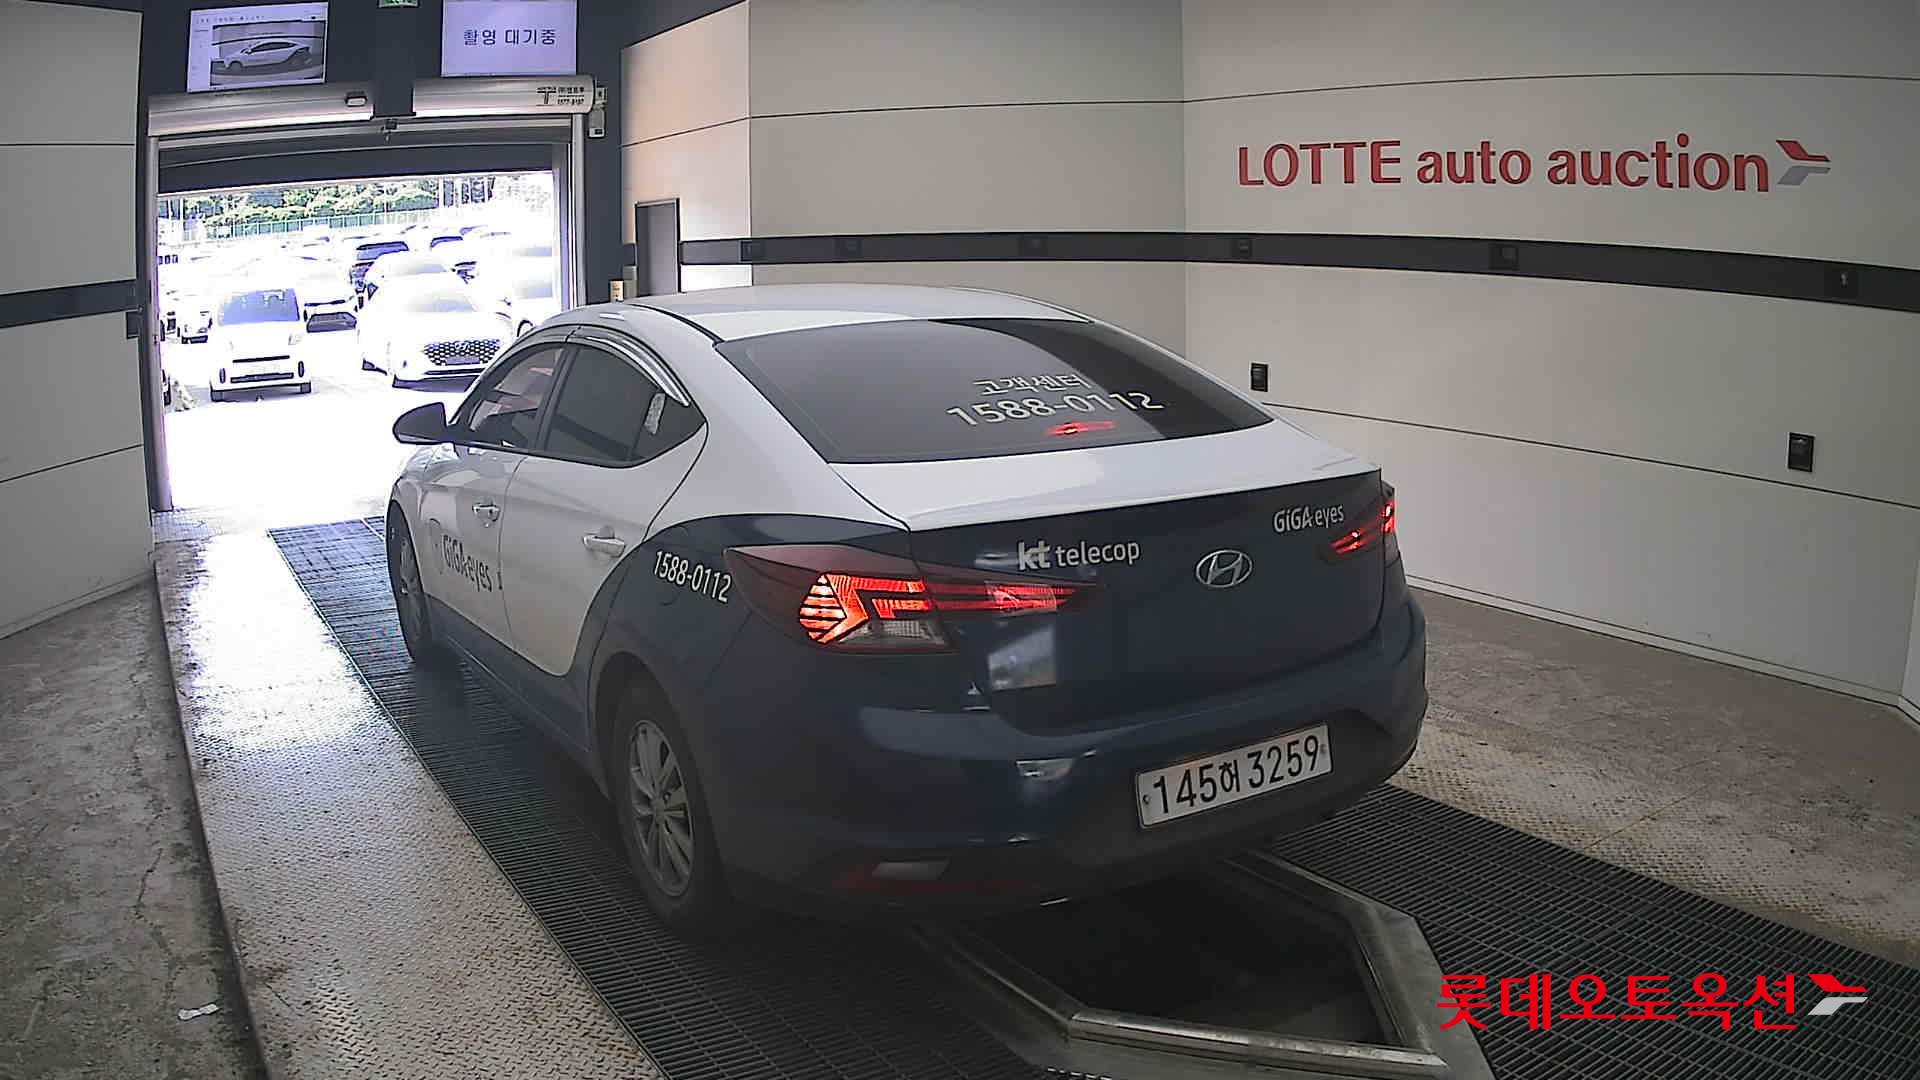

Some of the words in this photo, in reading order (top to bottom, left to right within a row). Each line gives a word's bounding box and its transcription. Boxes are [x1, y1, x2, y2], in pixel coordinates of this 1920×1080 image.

[464, 29, 497, 46] 촬영
[505, 29, 556, 46] 대기중
[1238, 140, 1401, 187] LOTTE
[1416, 140, 1532, 186] auto
[1546, 133, 1770, 193] auction
[973, 374, 1092, 396] 고객센터
[946, 392, 1165, 427] 1588-0112
[1017, 540, 1051, 571] kt
[1055, 540, 1140, 566] telecop
[654, 550, 732, 603] 1588-0112
